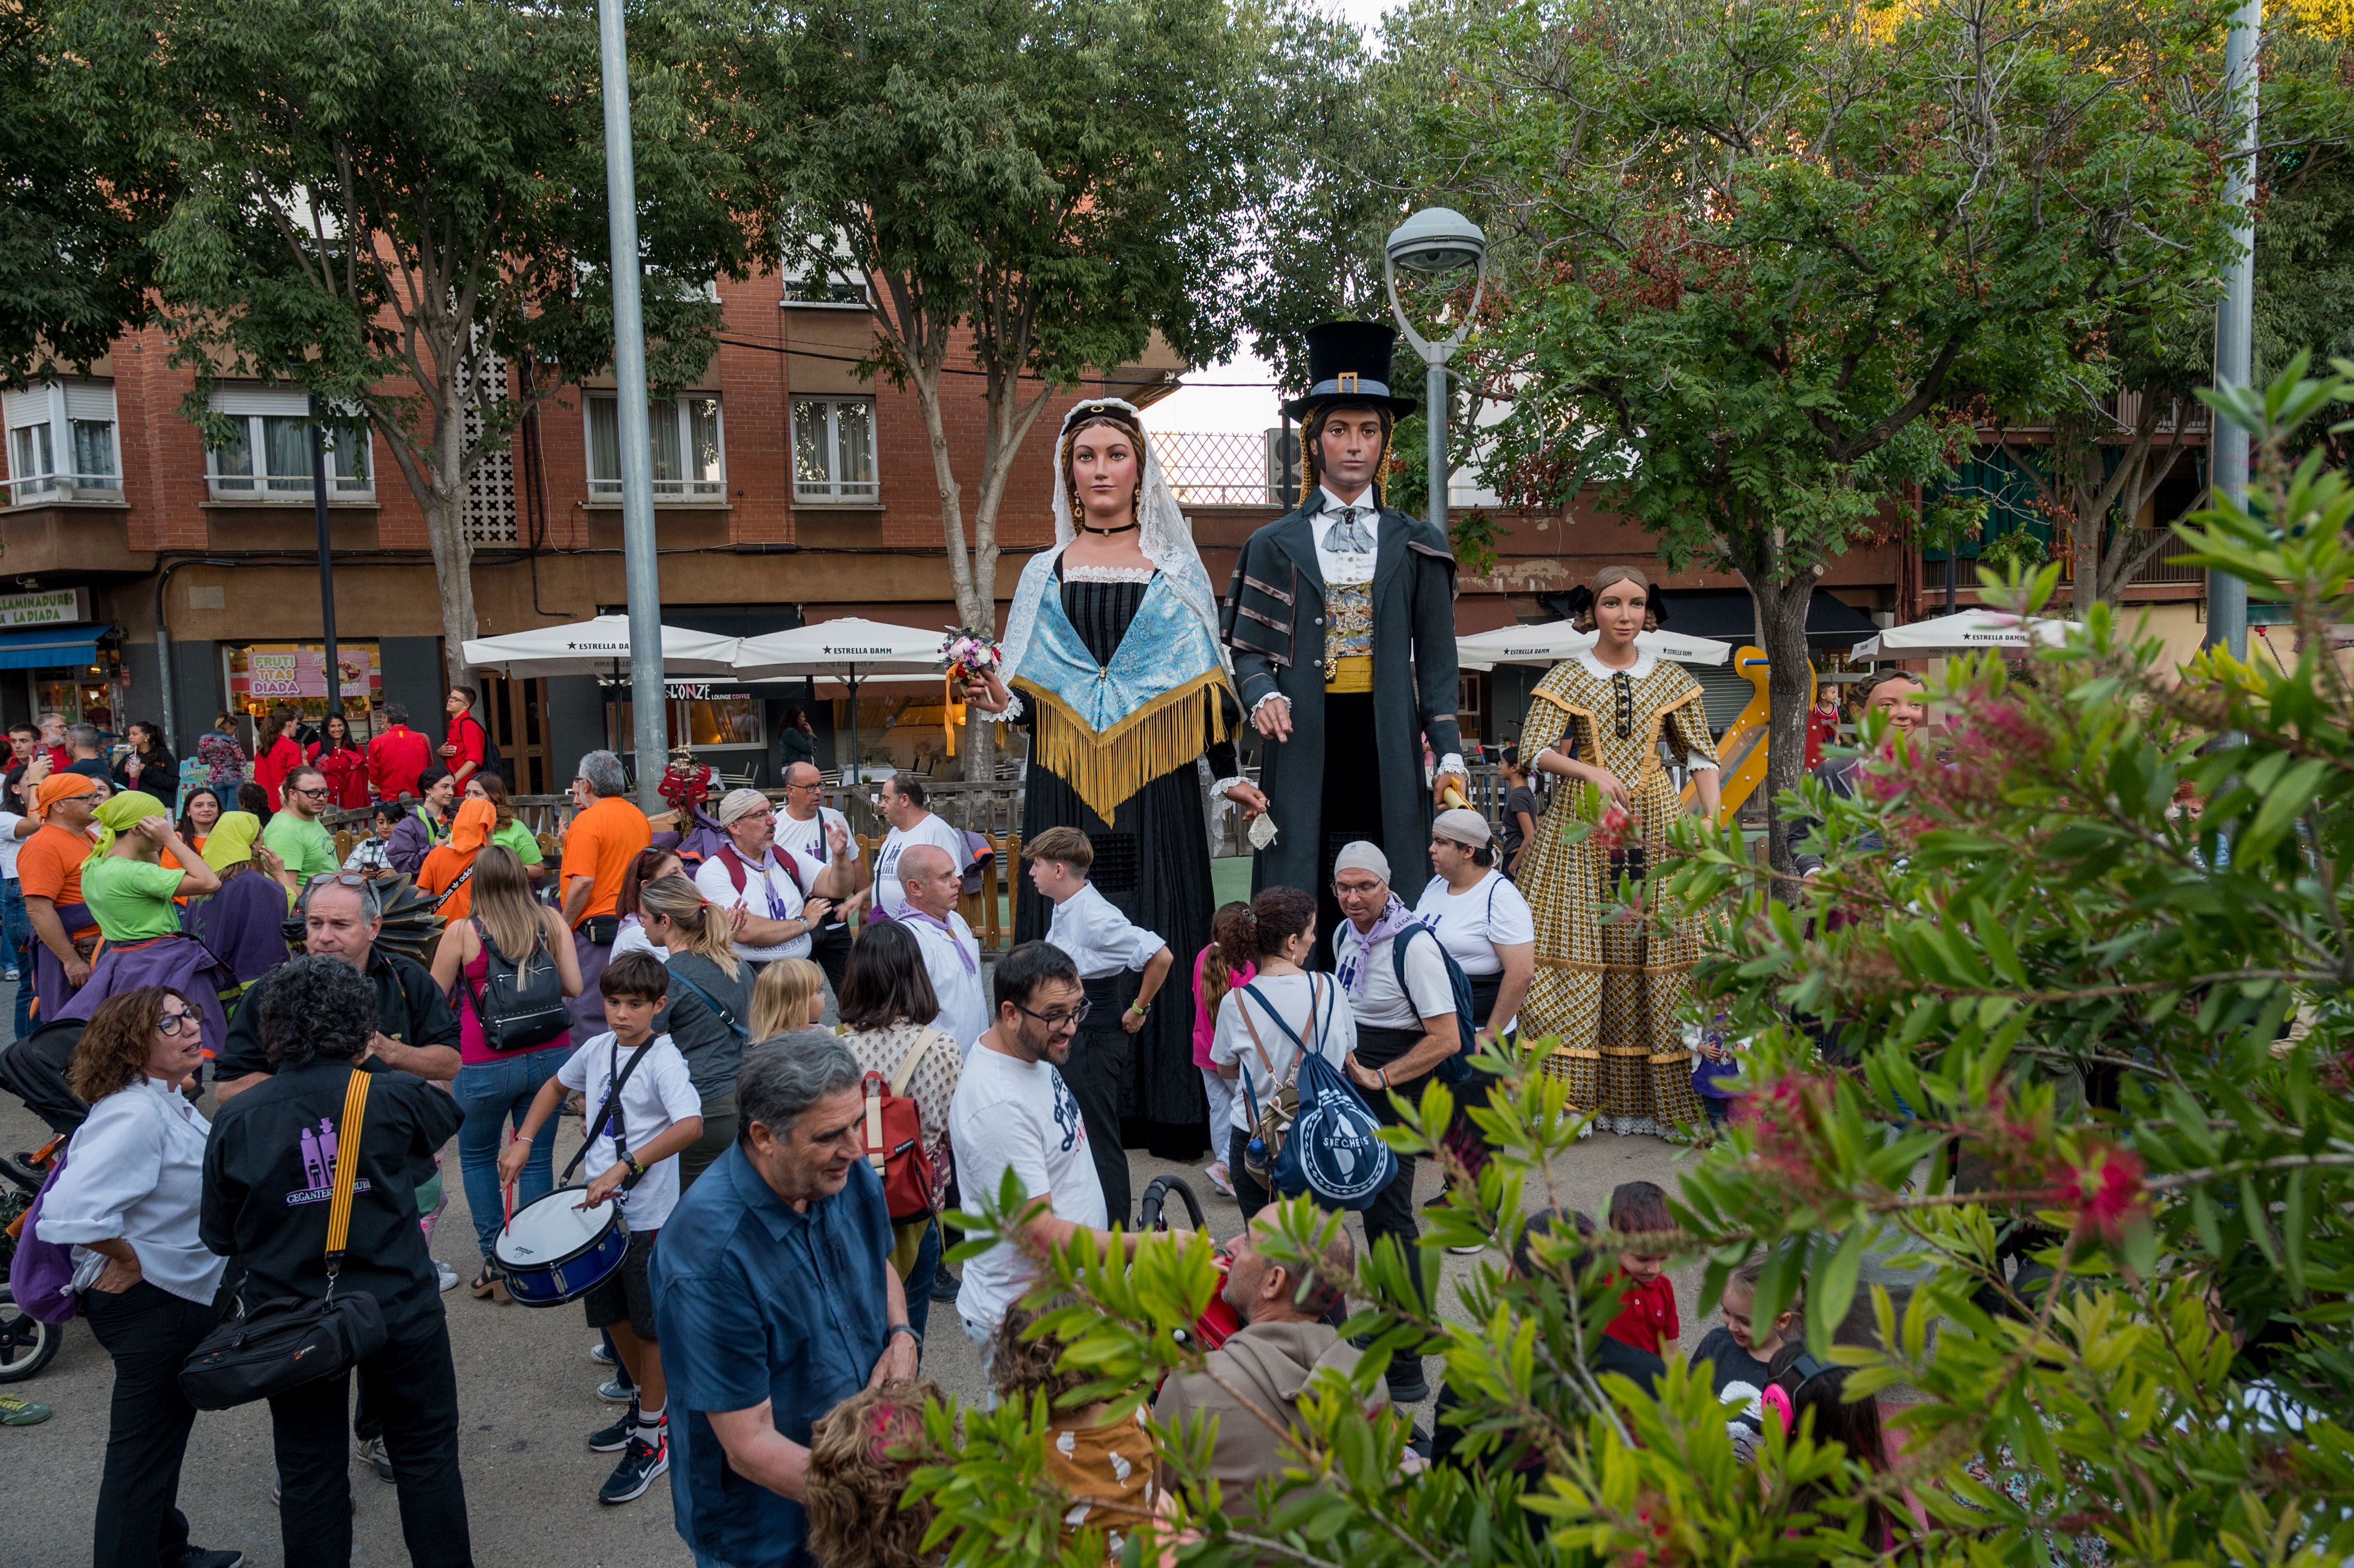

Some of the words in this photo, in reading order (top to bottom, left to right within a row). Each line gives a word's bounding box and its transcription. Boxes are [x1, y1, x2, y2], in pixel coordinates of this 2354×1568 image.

[14, 611, 25, 623] LA
[27, 608, 60, 622] DIADA
[254, 655, 295, 668] FRUTI
[257, 669, 294, 681] TTAS
[254, 682, 299, 694] DIADA
[671, 684, 710, 700] L'ONZE
[459, 865, 474, 882] adid
[437, 888, 453, 907] adidas
[754, 942, 791, 952] GEGANTERS
[790, 940, 798, 948] DE
